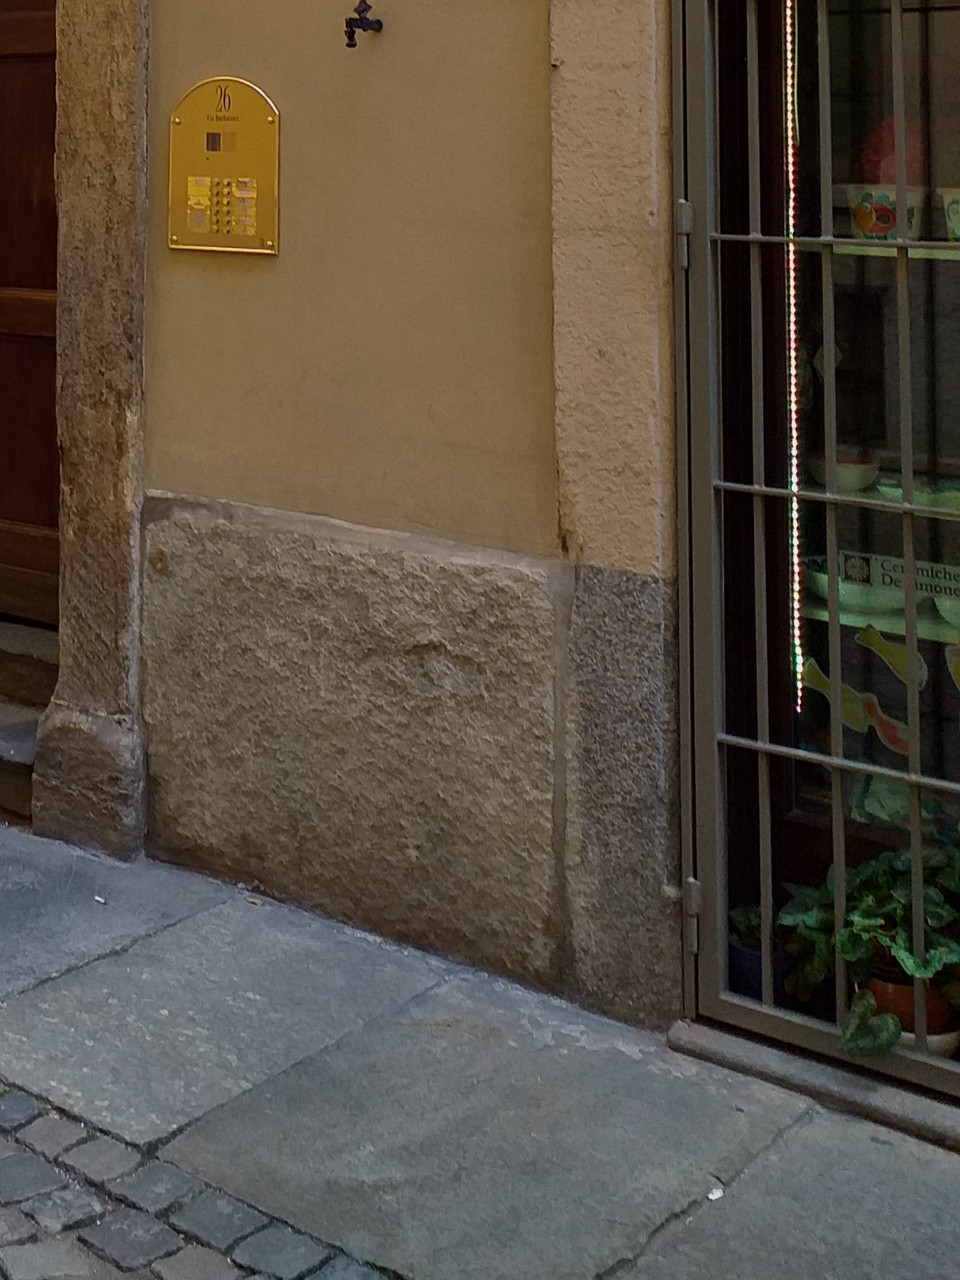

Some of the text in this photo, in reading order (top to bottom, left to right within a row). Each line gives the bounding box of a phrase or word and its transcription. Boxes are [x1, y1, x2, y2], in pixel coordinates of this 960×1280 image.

[215, 84, 232, 113] 26
[880, 558, 960, 583] Cermiche
[881, 572, 960, 598] De imone
